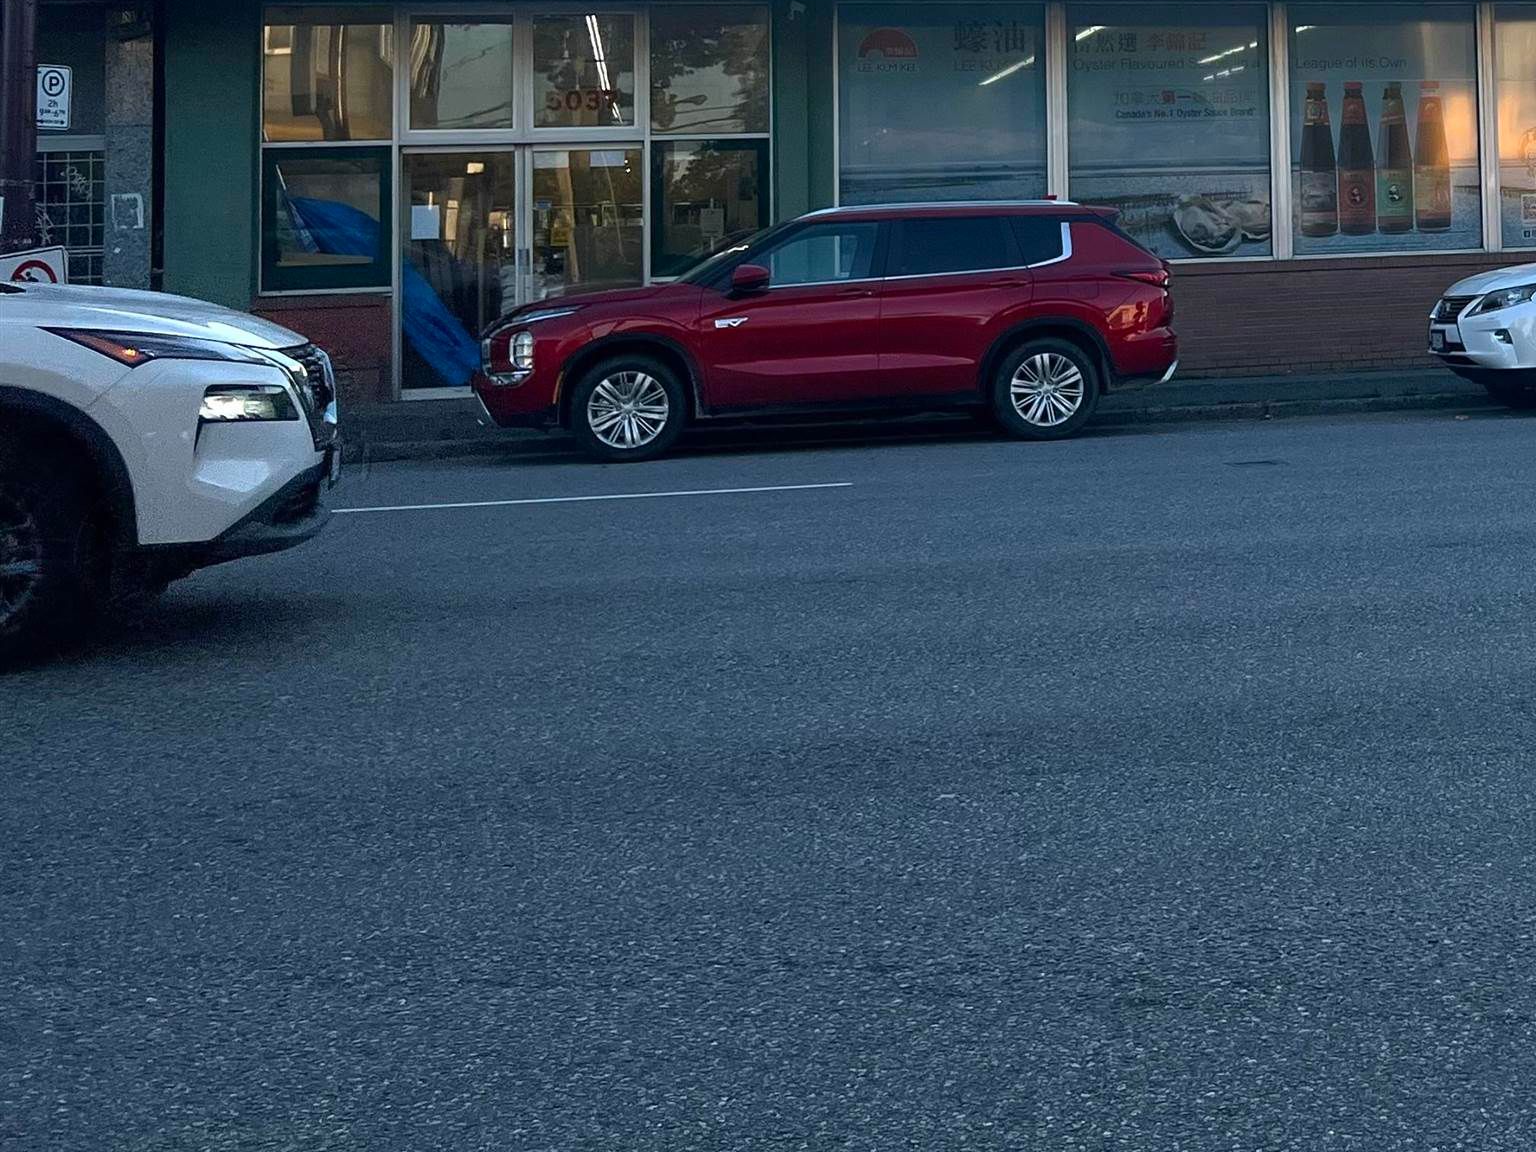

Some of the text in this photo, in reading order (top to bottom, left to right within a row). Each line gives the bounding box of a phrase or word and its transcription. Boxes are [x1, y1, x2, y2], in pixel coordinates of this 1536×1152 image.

[1073, 58, 1116, 73] Oyster
[1120, 57, 1184, 71] Flavoured
[1296, 56, 1341, 70] League
[1344, 56, 1358, 69] of
[1379, 57, 1408, 69] Own
